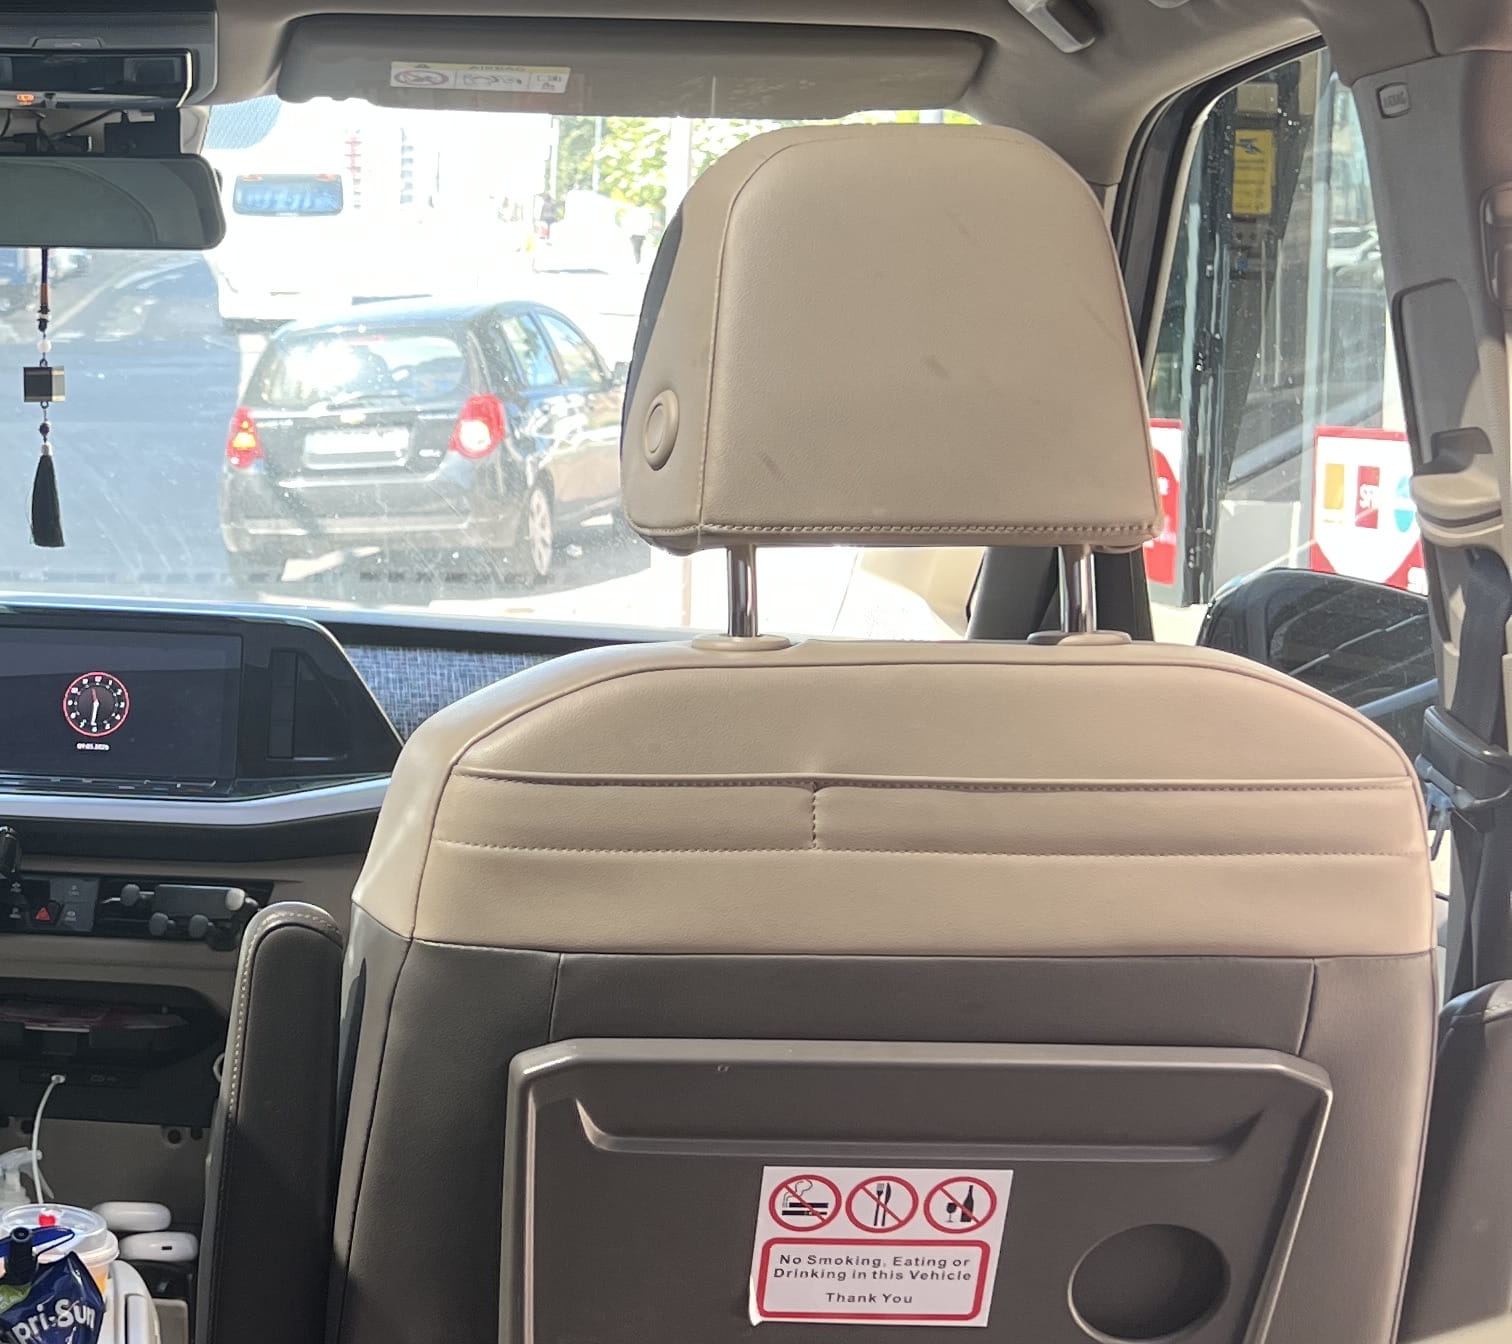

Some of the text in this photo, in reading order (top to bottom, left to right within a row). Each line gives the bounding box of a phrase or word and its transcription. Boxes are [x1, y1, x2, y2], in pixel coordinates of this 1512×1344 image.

[779, 1254, 801, 1265] No
[893, 1256, 947, 1269] Eating
[952, 1257, 970, 1267] or
[774, 1267, 972, 1282] Drinking in this Vehicle
[825, 1292, 913, 1304] Thank You
